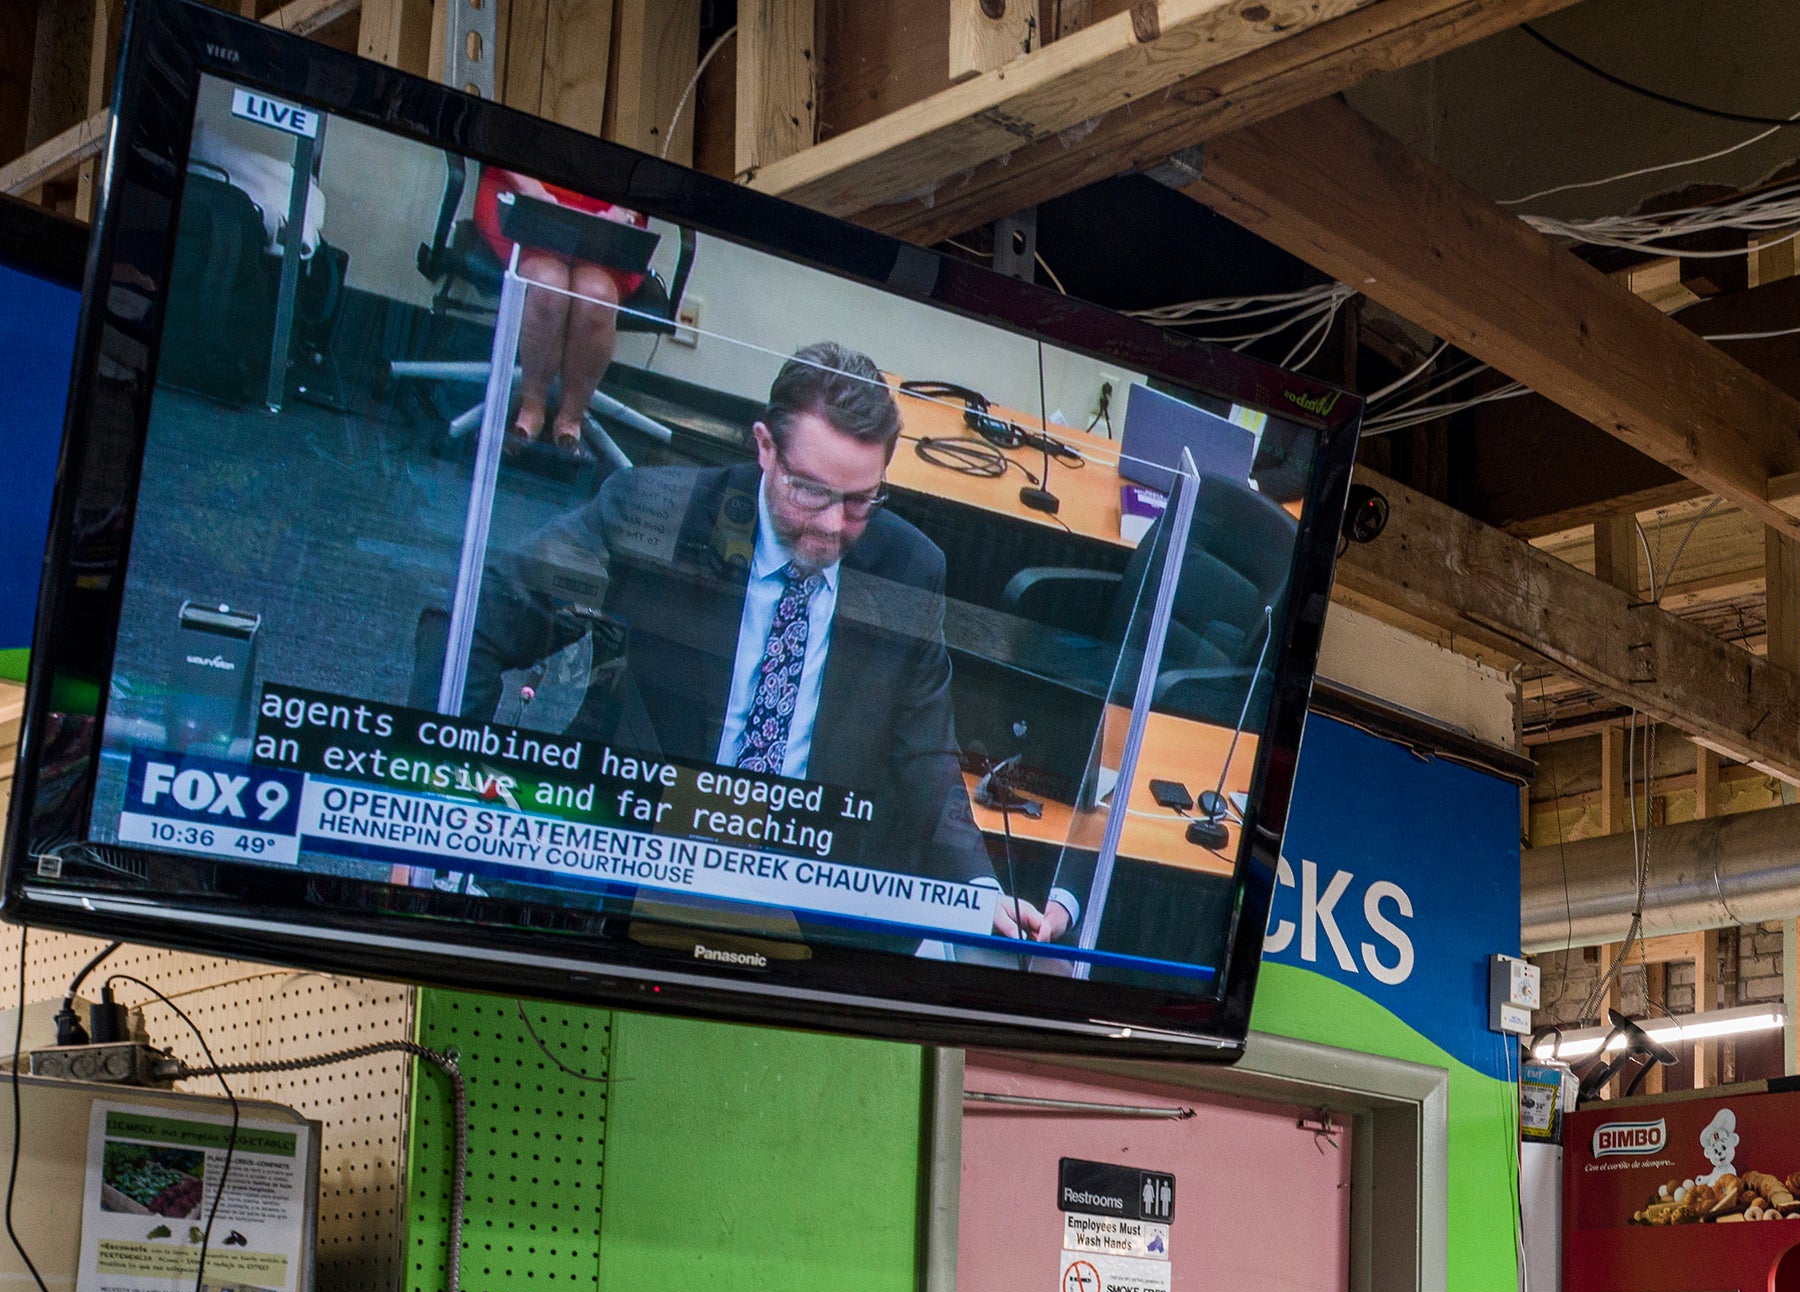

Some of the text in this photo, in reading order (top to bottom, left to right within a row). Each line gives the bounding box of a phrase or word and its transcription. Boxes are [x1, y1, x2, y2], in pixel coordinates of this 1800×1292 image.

[246, 96, 306, 131] LIVE
[261, 693, 873, 821] agents combined have engaged in
[142, 761, 289, 821] FOX 9
[256, 734, 833, 856] an extensive and far reaching
[151, 822, 276, 853] 10:36 49°
[319, 813, 694, 884] HENNEPIN COUNTY COURTHOUSE
[322, 787, 981, 911] OPENING STATEMENTS IN DEREK CHAUVIN TRIAL
[1263, 856, 1414, 985] CKS
[694, 945, 767, 967] Panasonic
[1598, 1128, 1661, 1149] BIMBO
[1064, 1187, 1124, 1209] Restrooms
[1068, 1216, 1141, 1236] Employees Must
[1077, 1233, 1132, 1250] Wash Hands
